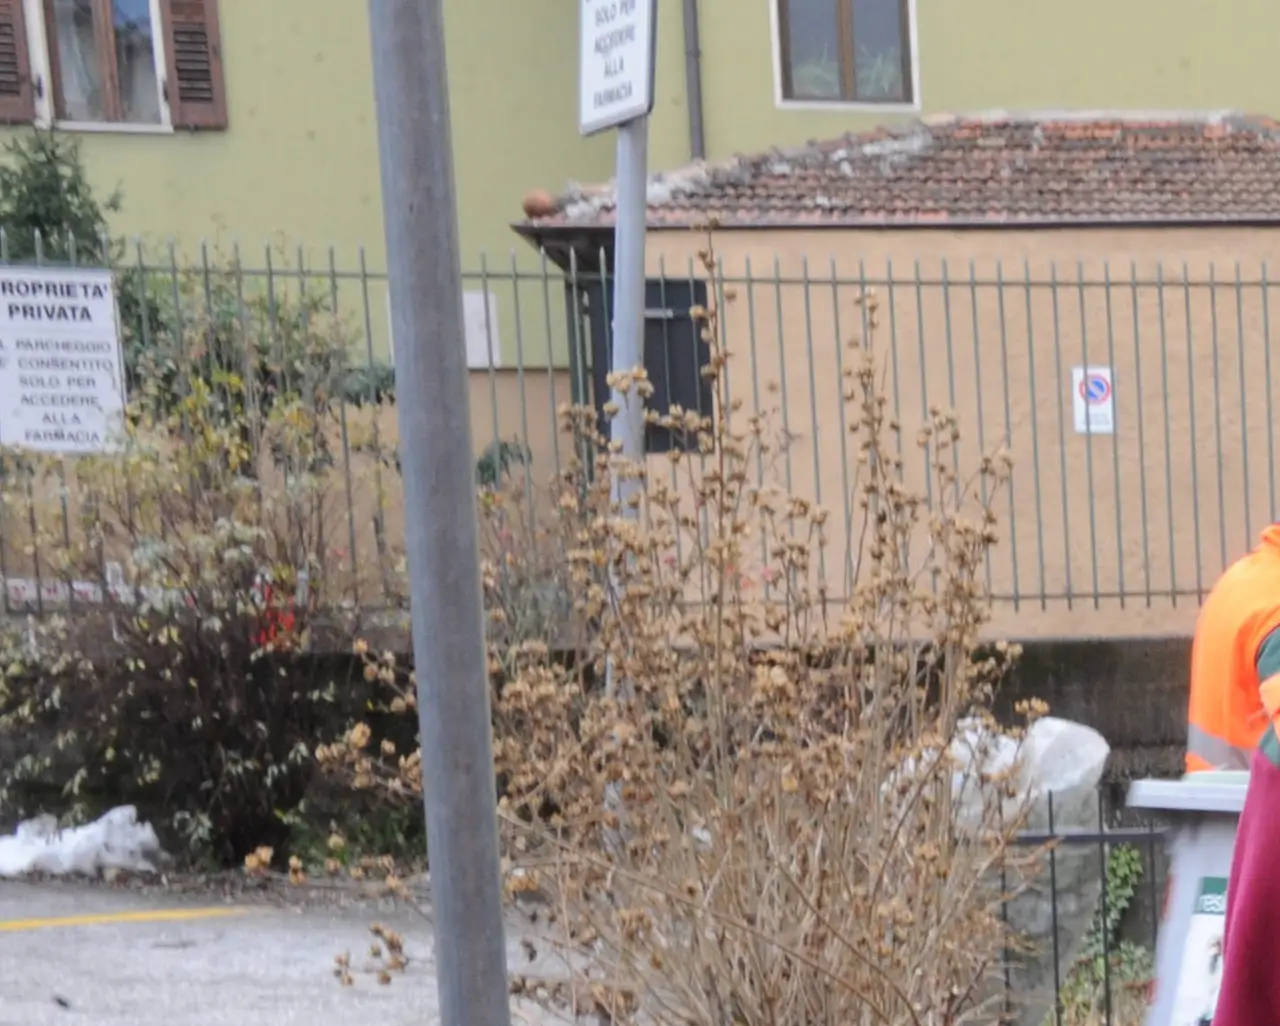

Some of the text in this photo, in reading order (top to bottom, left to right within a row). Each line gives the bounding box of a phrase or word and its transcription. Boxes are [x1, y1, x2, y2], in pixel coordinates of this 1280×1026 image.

[8, 303, 93, 322] PRIVATA
[19, 375, 97, 390] SOLO PER
[20, 394, 100, 408] ACCEDERE
[42, 411, 82, 426] ALLA
[24, 429, 101, 443] FARMACIA
